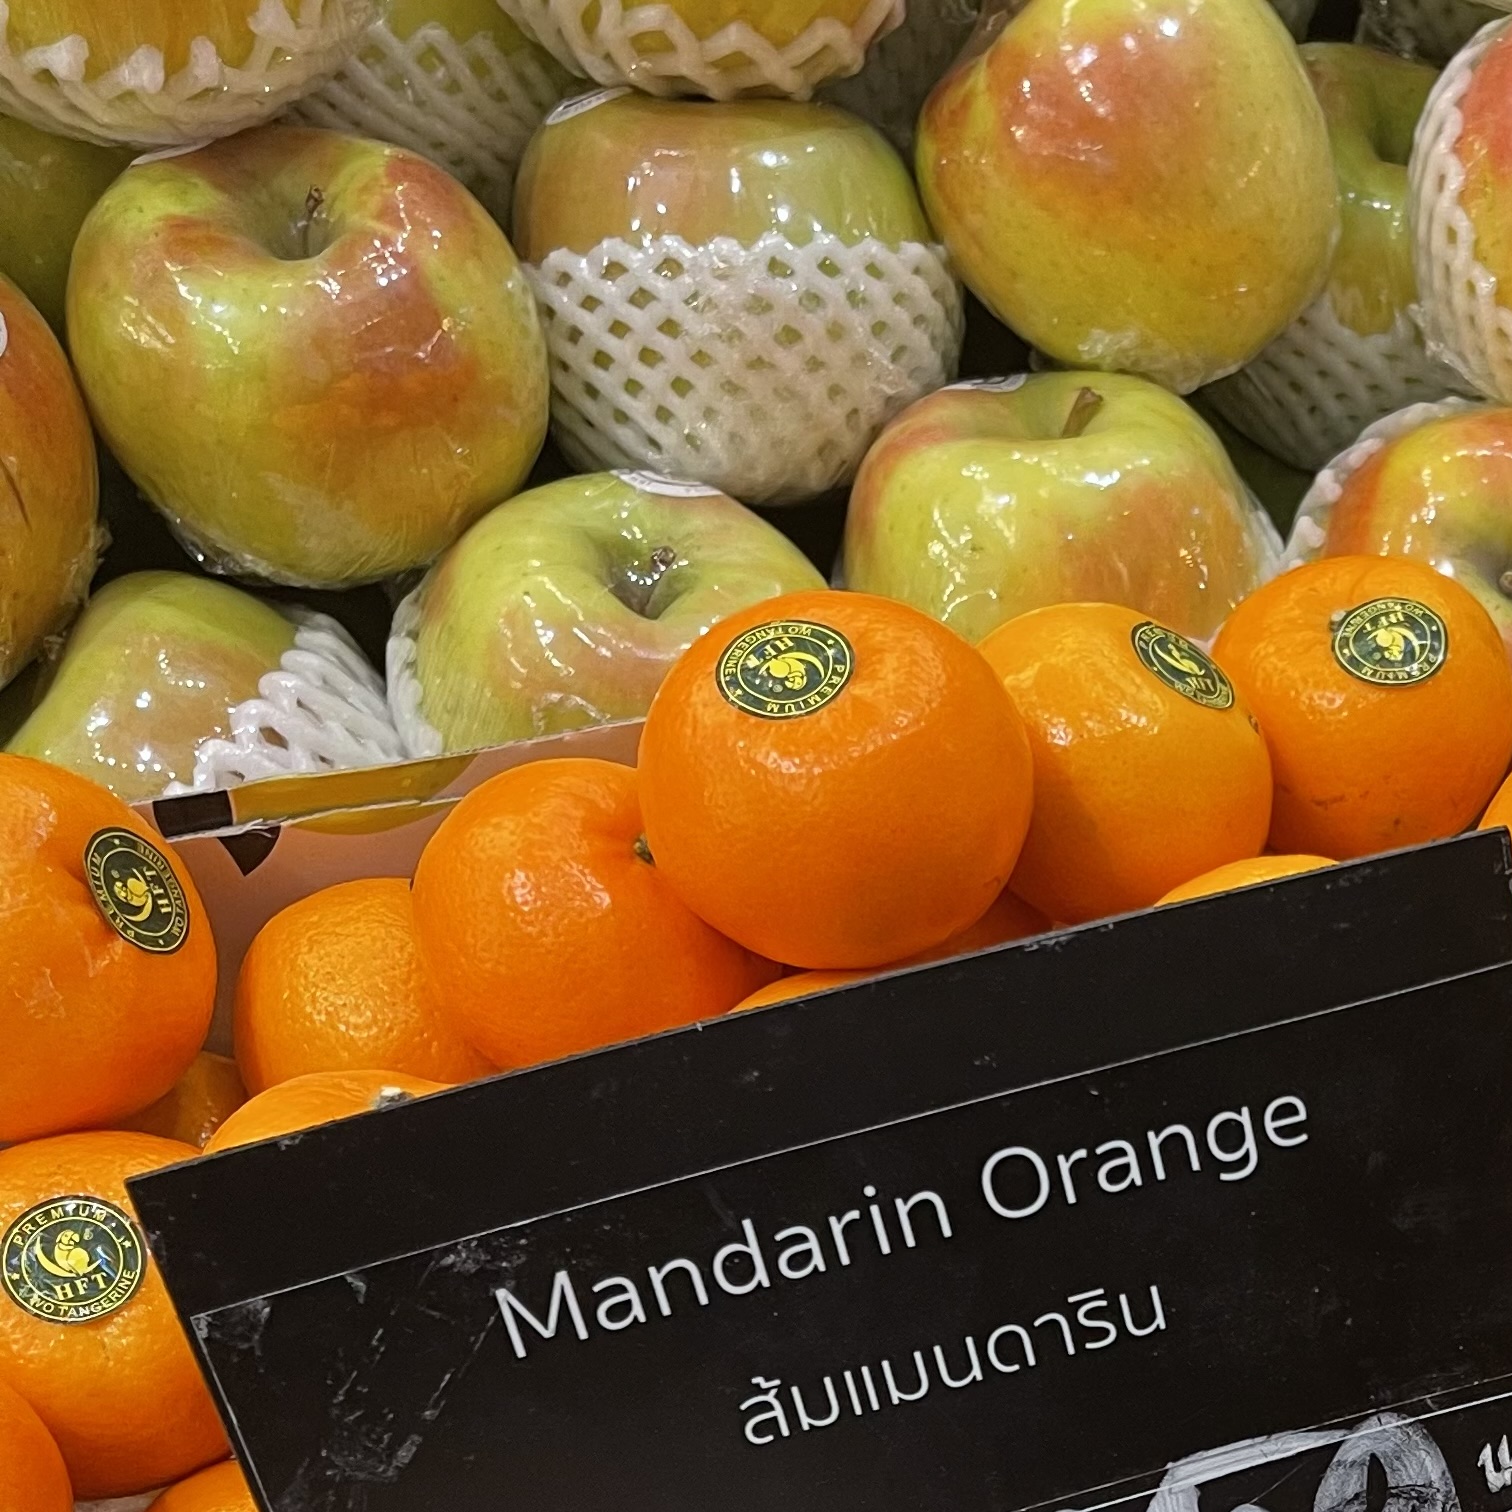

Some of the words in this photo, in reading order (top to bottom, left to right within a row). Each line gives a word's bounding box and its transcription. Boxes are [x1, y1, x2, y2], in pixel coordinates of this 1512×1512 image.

[744, 637, 794, 668] HFT
[788, 626, 812, 635] WO
[766, 664, 844, 713] PREMIUM
[90, 852, 134, 938] PREMIUM
[143, 866, 172, 914] HFT
[14, 1207, 106, 1246] PREMIUM
[495, 1185, 953, 1358] Mandarin
[981, 1095, 1309, 1220] Orange
[54, 1273, 108, 1301] HFT
[58, 1269, 137, 1318] TANGERINE
[740, 1285, 1167, 1445] ส้มแมนดาริน
